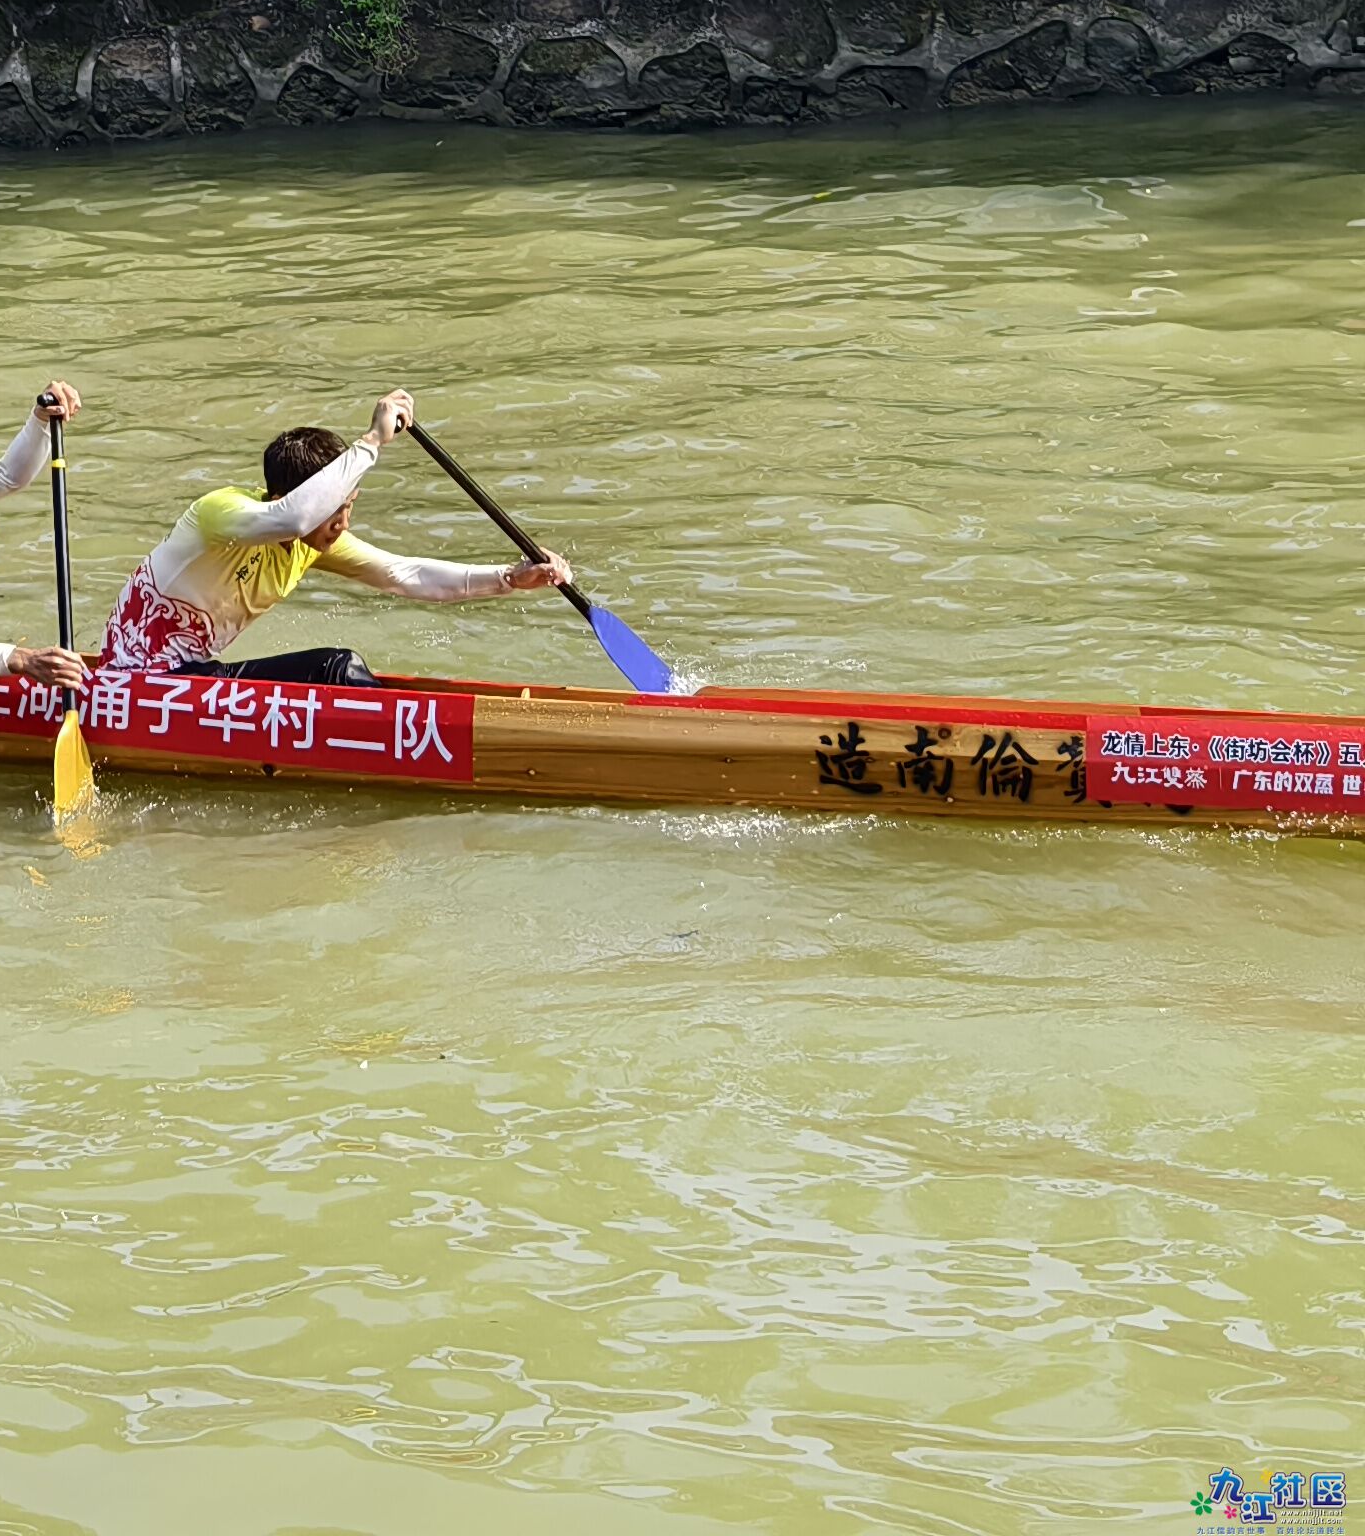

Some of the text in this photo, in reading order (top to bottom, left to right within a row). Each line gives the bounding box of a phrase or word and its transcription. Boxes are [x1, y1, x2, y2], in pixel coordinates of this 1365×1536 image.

[1101, 729, 1365, 766] 龙情上东·《街坊会杯》五
[1232, 769, 1335, 795] 广东的双蒸
